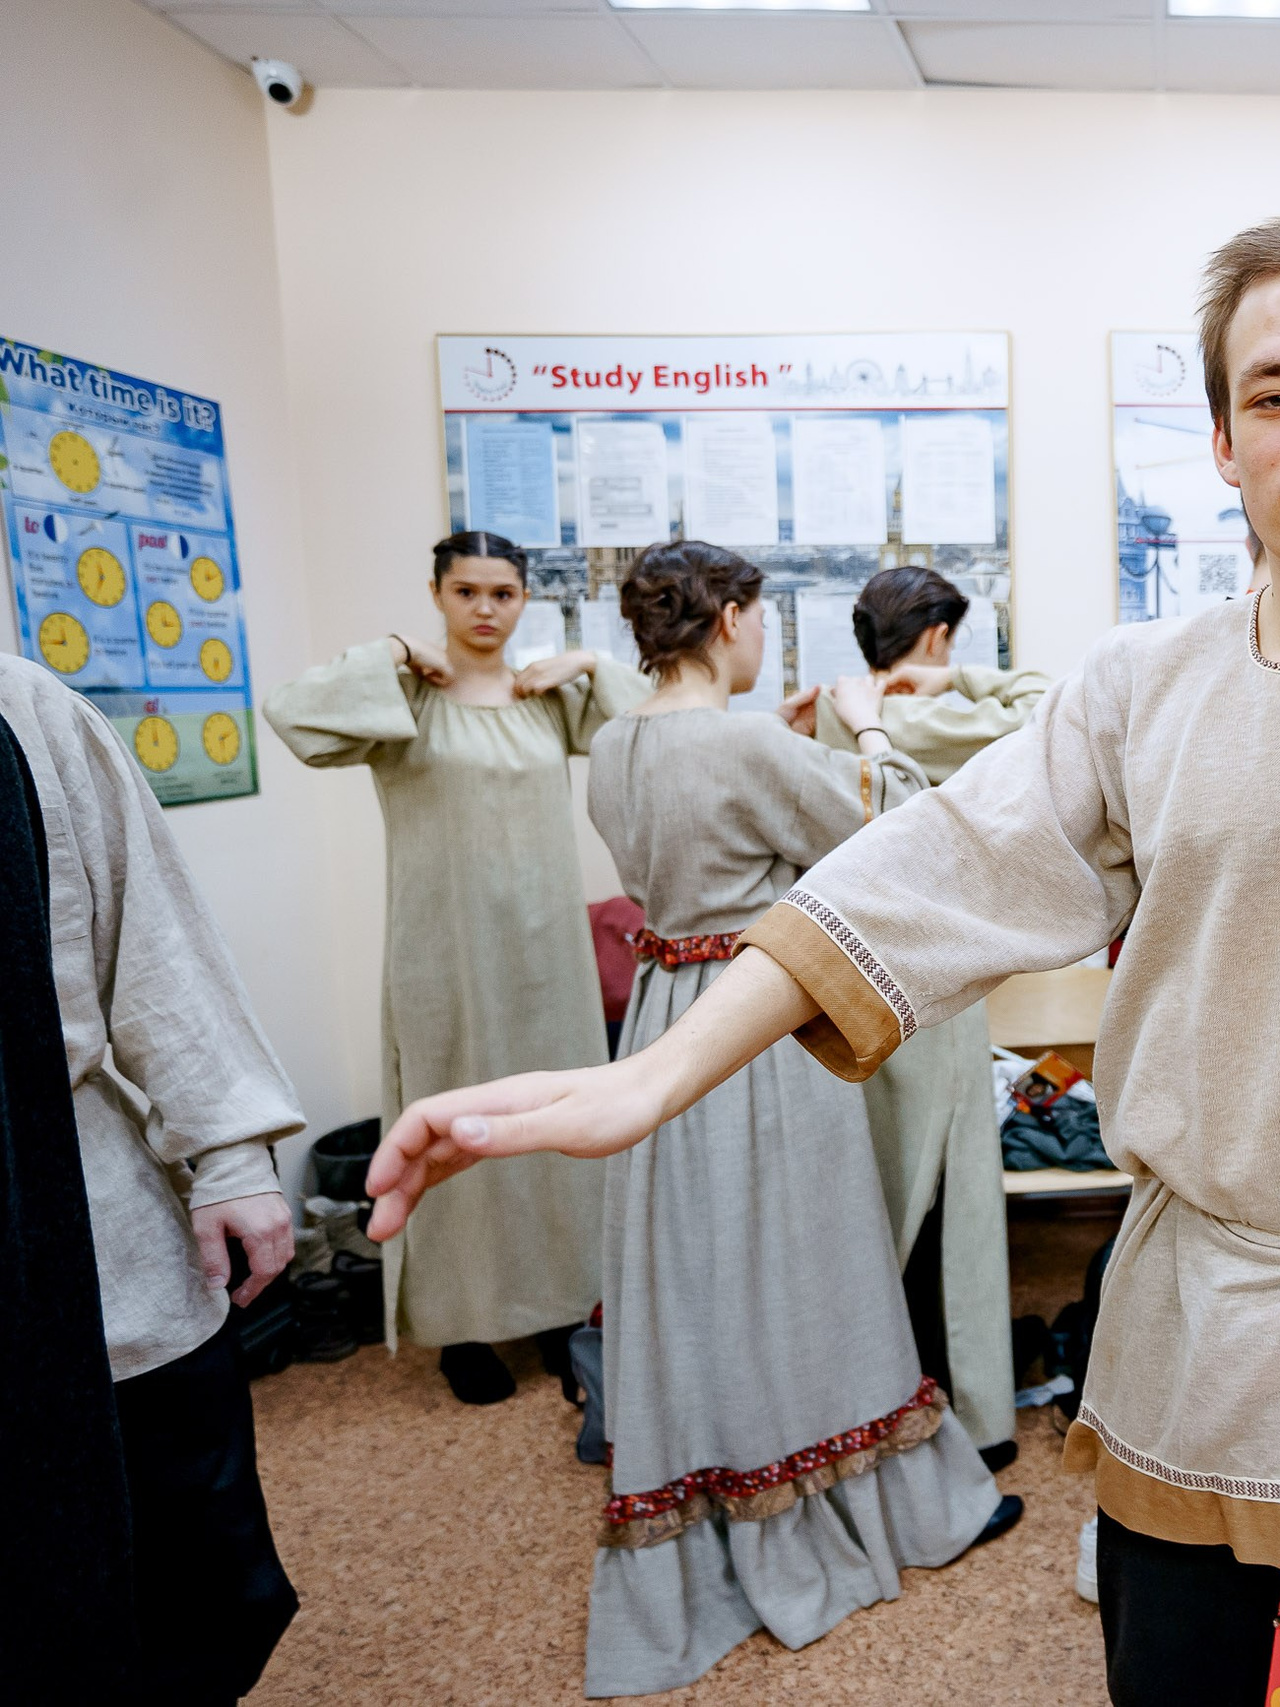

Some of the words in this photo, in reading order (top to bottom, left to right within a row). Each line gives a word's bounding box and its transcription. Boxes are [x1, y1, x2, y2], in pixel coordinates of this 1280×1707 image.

[0, 347, 81, 392] What
[89, 371, 151, 412] time
[157, 390, 180, 419] is
[184, 397, 215, 430] it?
[653, 364, 769, 395] English
